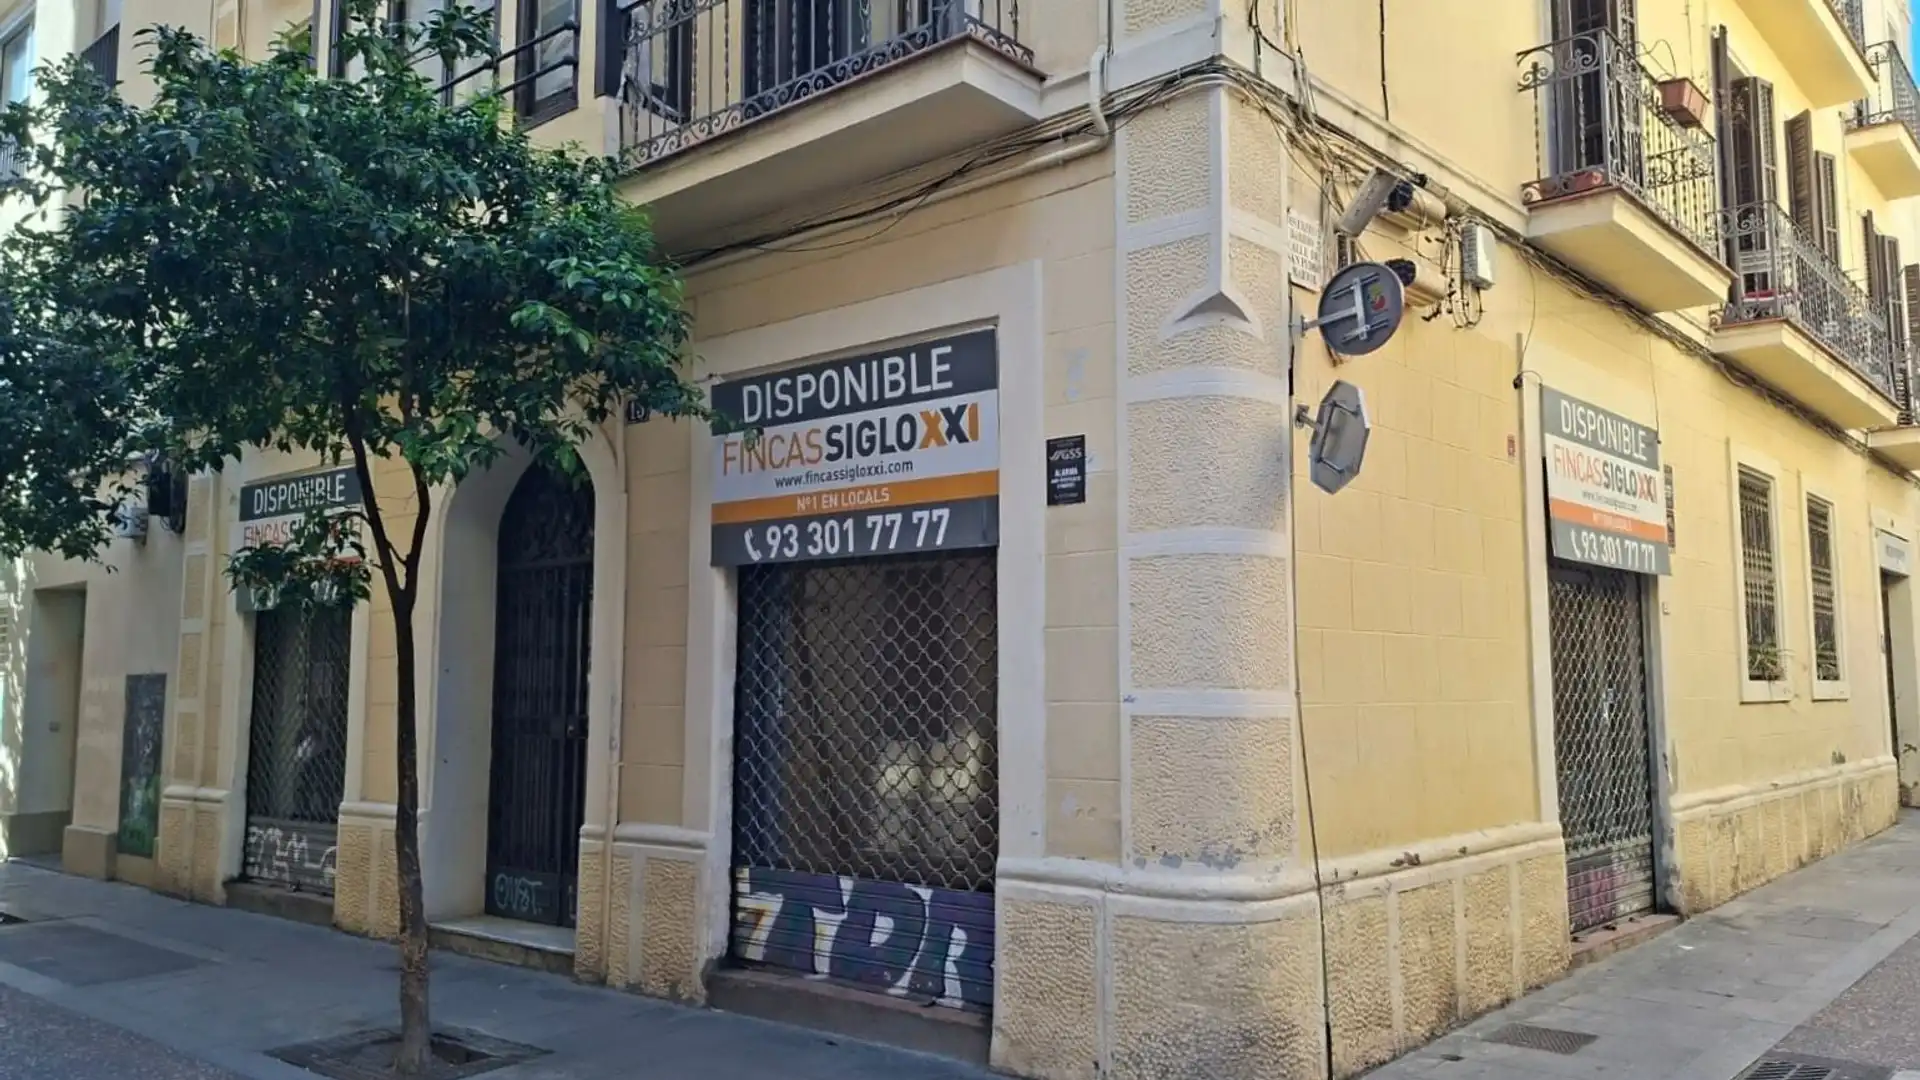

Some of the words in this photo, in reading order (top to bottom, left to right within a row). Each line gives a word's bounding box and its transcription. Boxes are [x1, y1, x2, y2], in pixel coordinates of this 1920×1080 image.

[743, 345, 953, 424] DISPONIBLE
[1560, 398, 1648, 461] DISPONIBLE
[774, 460, 914, 488] www.fincassigloxxi.com
[821, 492, 838, 510] EN
[840, 487, 890, 509] LOCALS
[766, 523, 799, 559] 93
[807, 518, 855, 556] 301
[866, 512, 903, 551] 77
[912, 507, 951, 548] 77
[1581, 530, 1598, 562] 93
[1601, 534, 1622, 565] 301
[1624, 538, 1639, 569] 77
[1640, 542, 1656, 571] 77
